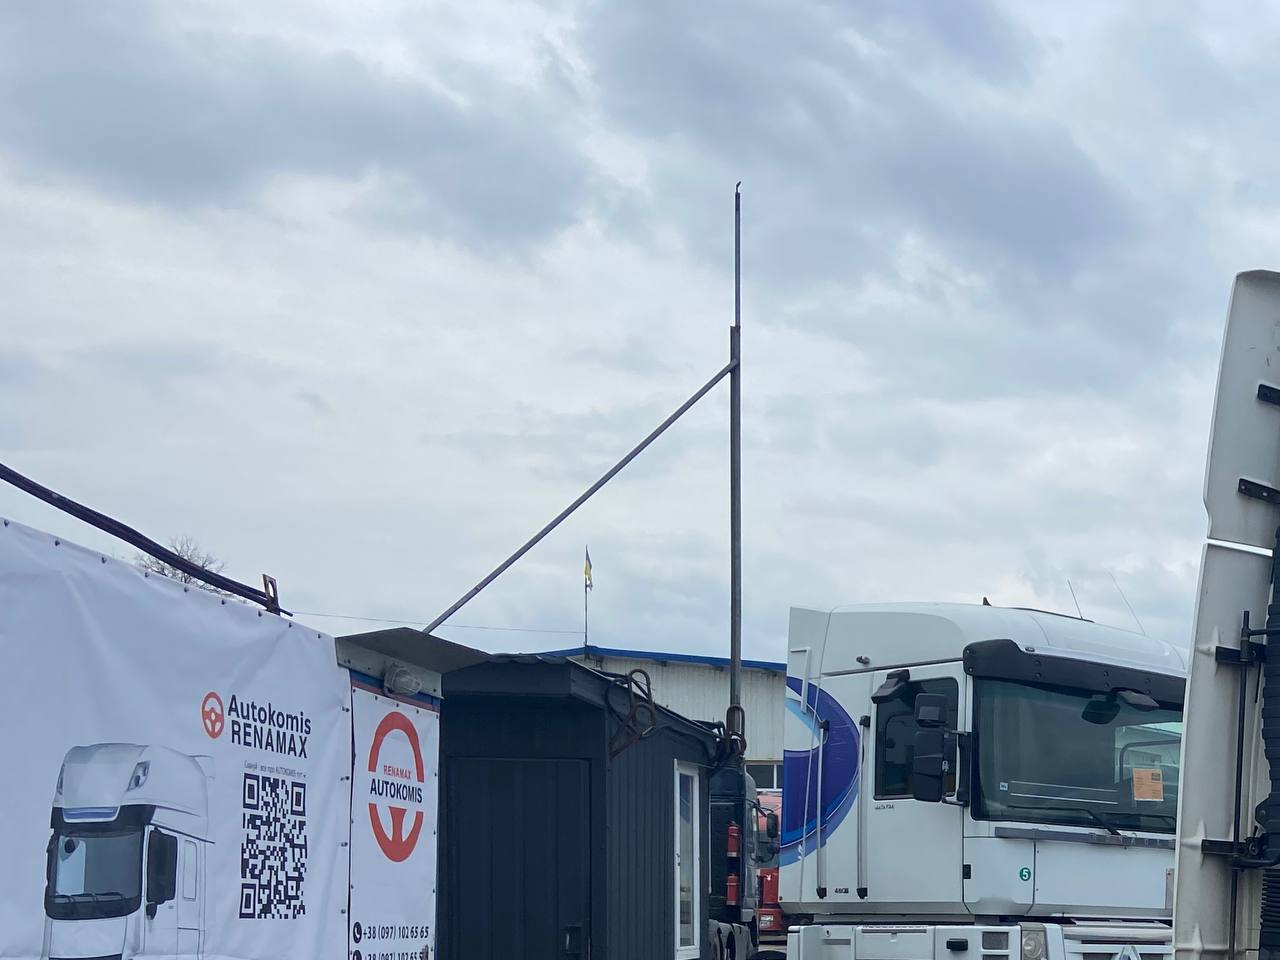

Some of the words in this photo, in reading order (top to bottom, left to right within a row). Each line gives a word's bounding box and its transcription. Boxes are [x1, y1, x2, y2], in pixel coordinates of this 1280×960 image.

[228, 694, 311, 735] Autokomis
[231, 720, 308, 759] RENAMAX
[384, 764, 411, 780] RENAMAX
[370, 778, 423, 803] AUTOKOMIS
[1022, 870, 1029, 880] 5
[363, 926, 376, 939] +38
[378, 925, 396, 940] (097)
[410, 926, 418, 939] 65
[420, 926, 429, 939] 65
